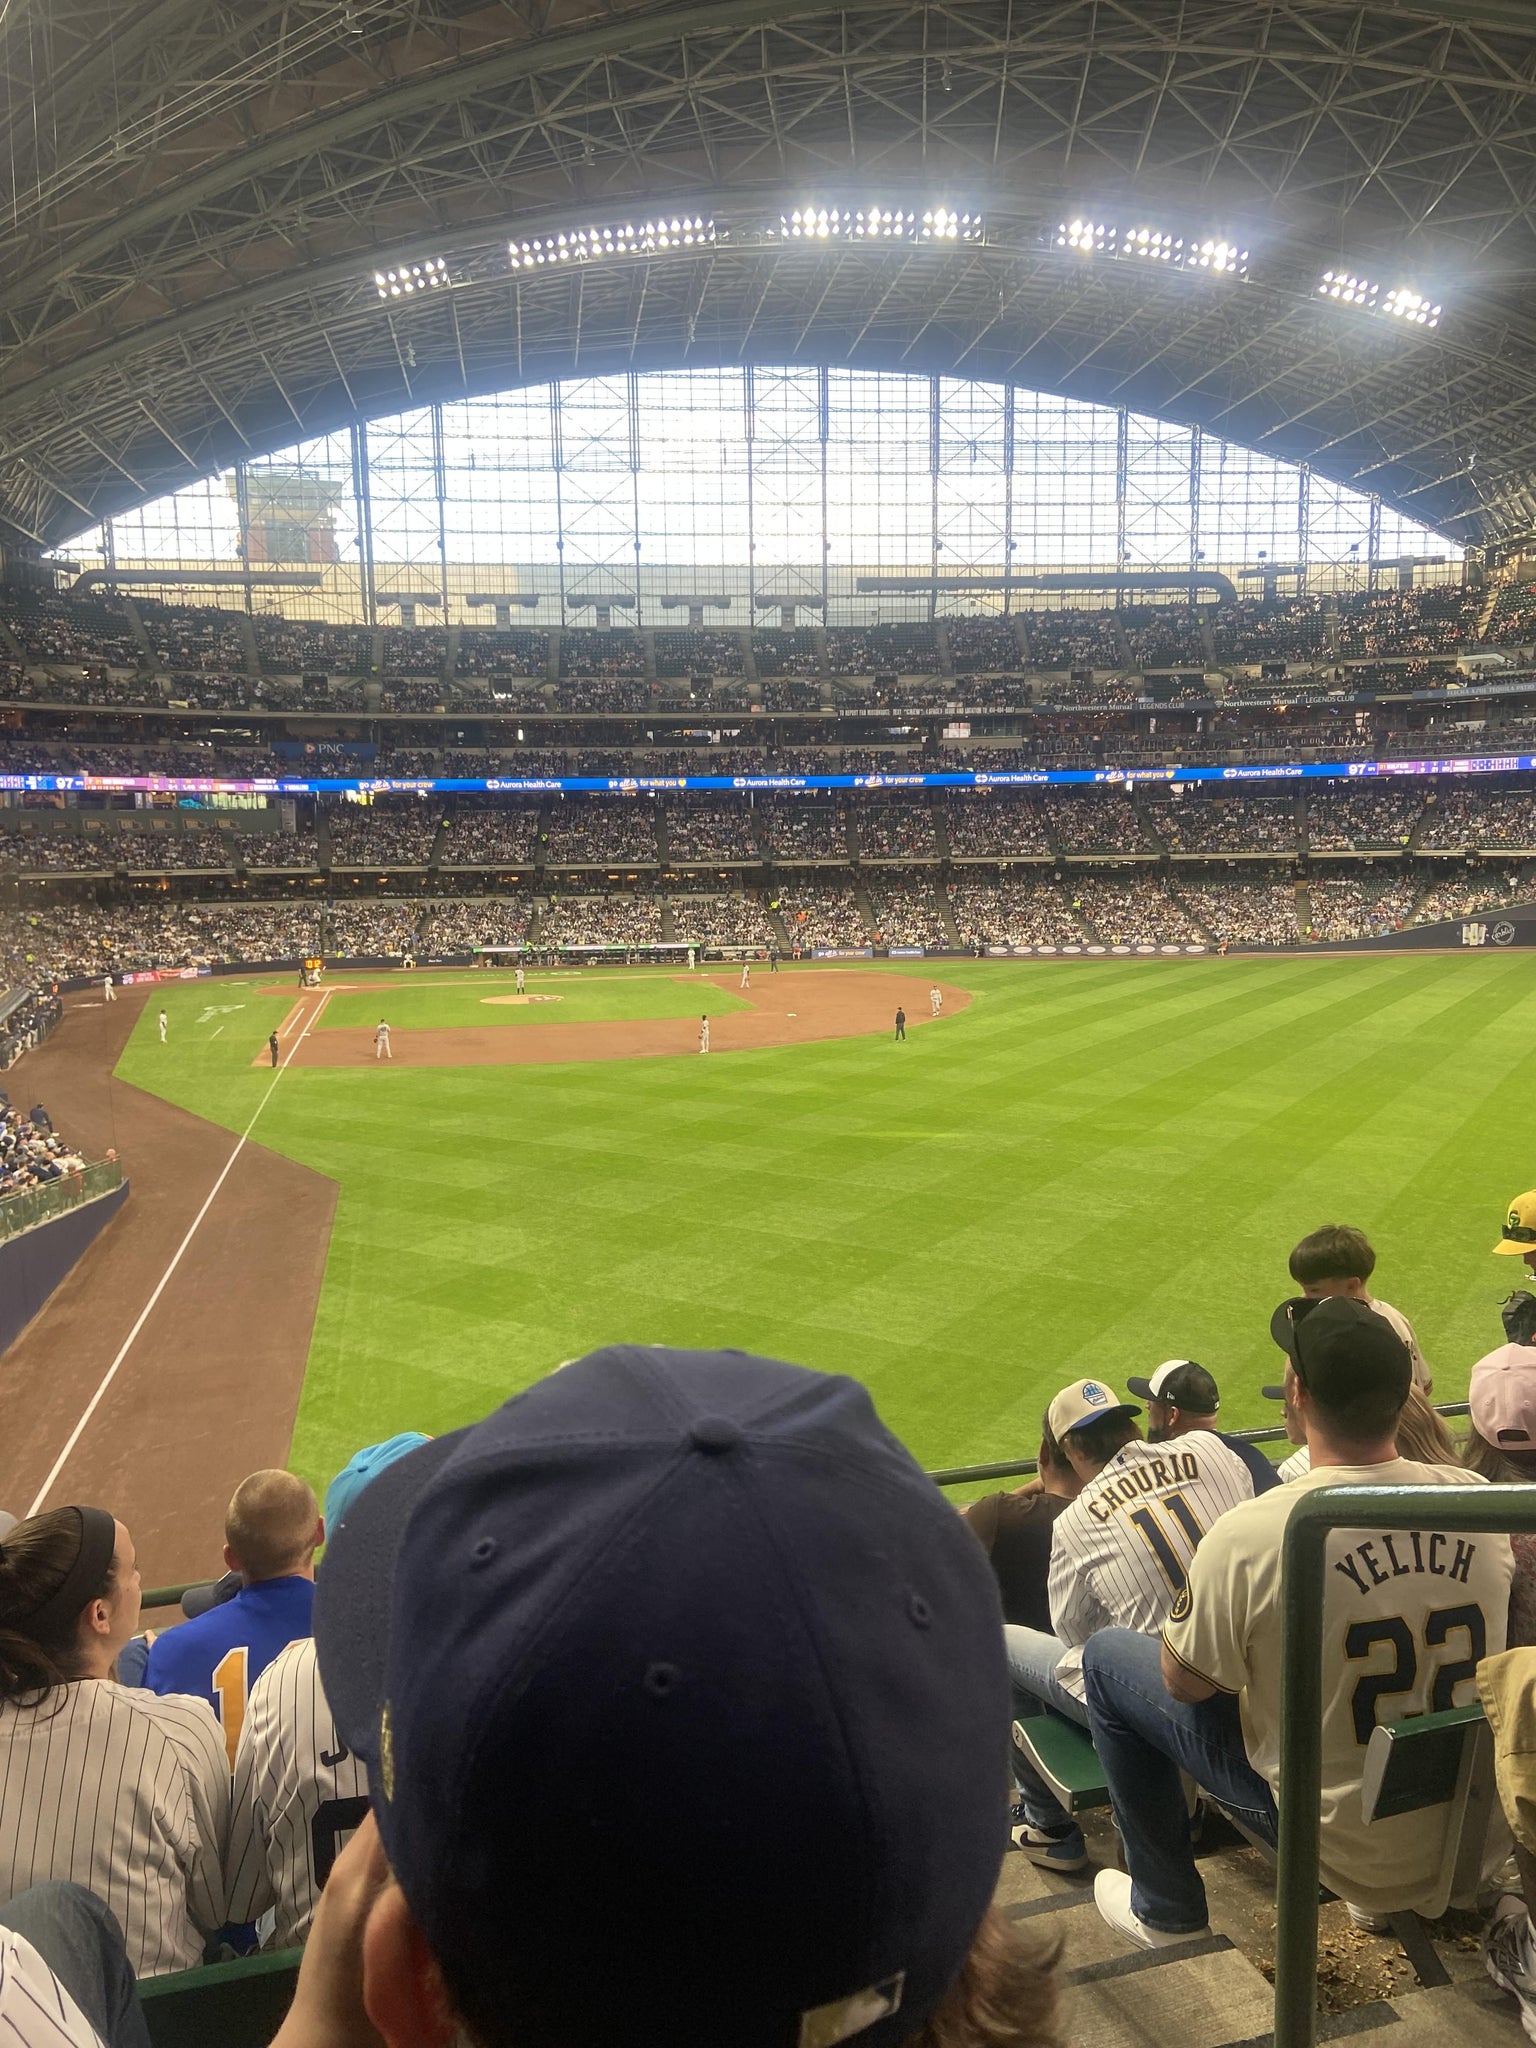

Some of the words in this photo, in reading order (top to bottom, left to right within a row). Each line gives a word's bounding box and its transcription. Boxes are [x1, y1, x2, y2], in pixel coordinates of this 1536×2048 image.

[318, 744, 345, 754] PNC
[56, 777, 73, 789] 97
[359, 781, 369, 790] go
[1349, 764, 1366, 775] 97
[1088, 1452, 1199, 1522] CHOURIO
[1128, 1490, 1207, 1595] 11
[1334, 1532, 1476, 1594] YELICH
[1343, 1602, 1487, 1747] 22
